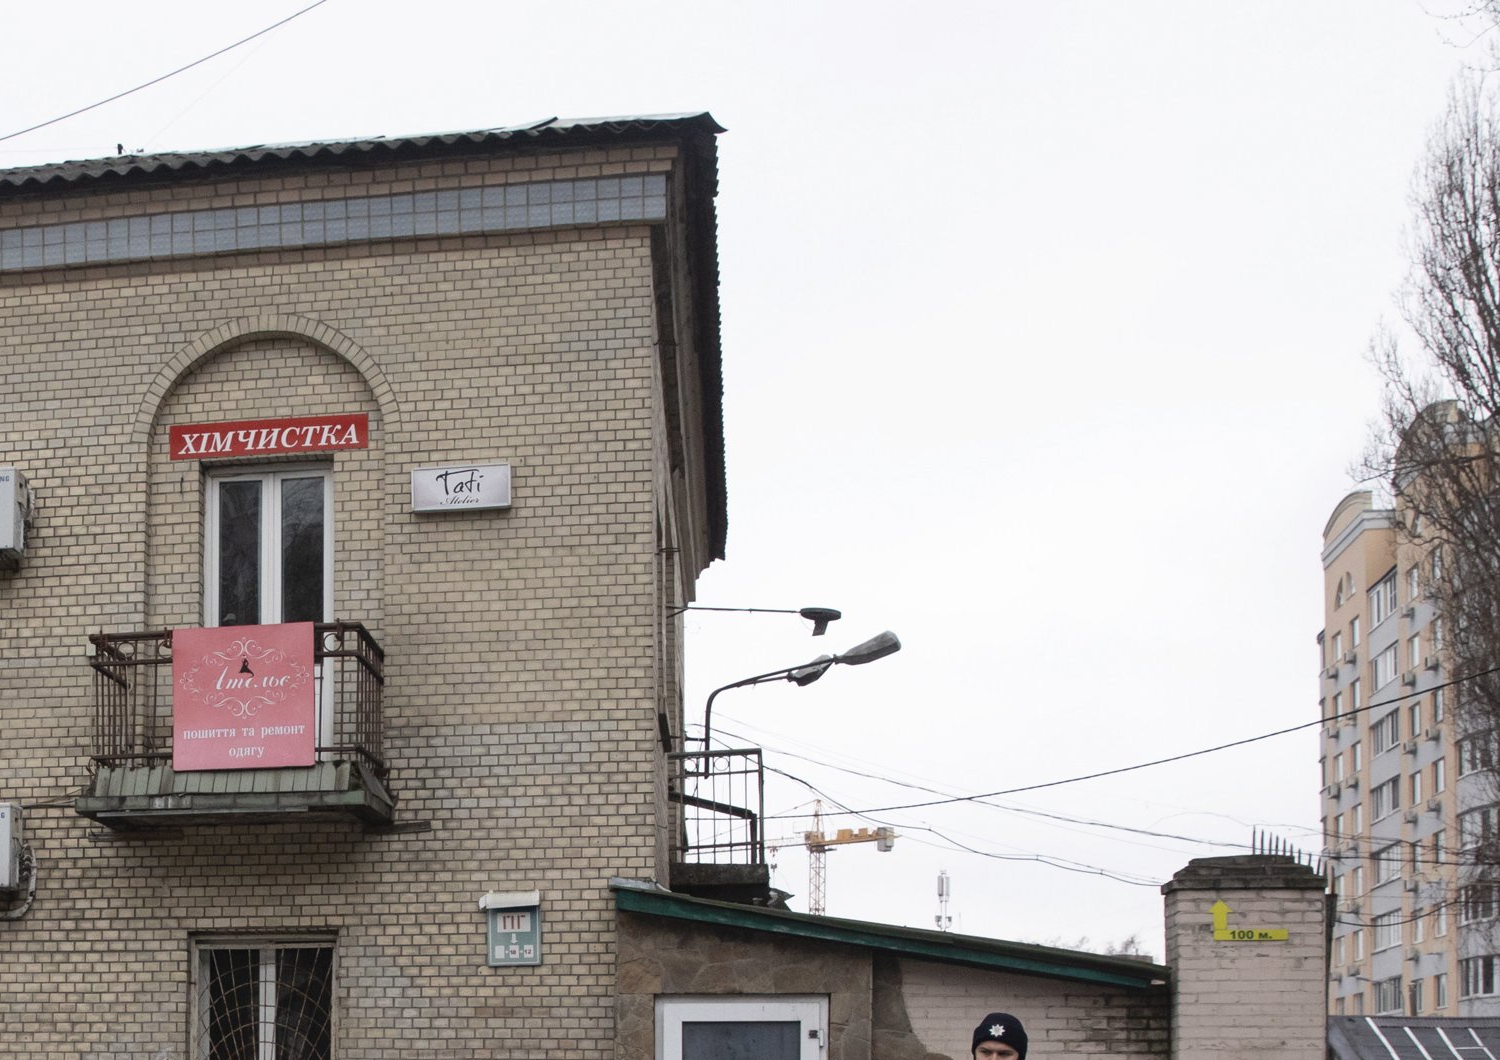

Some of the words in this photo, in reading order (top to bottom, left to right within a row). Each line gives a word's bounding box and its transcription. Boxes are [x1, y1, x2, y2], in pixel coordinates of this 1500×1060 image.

[178, 423, 361, 455] ХІМЧИСТКА
[435, 468, 484, 495] Tati
[183, 726, 236, 740] пошиття
[241, 725, 255, 738] та
[261, 723, 305, 740] ремонт
[228, 743, 265, 759] одягу
[1230, 930, 1254, 940] 100
